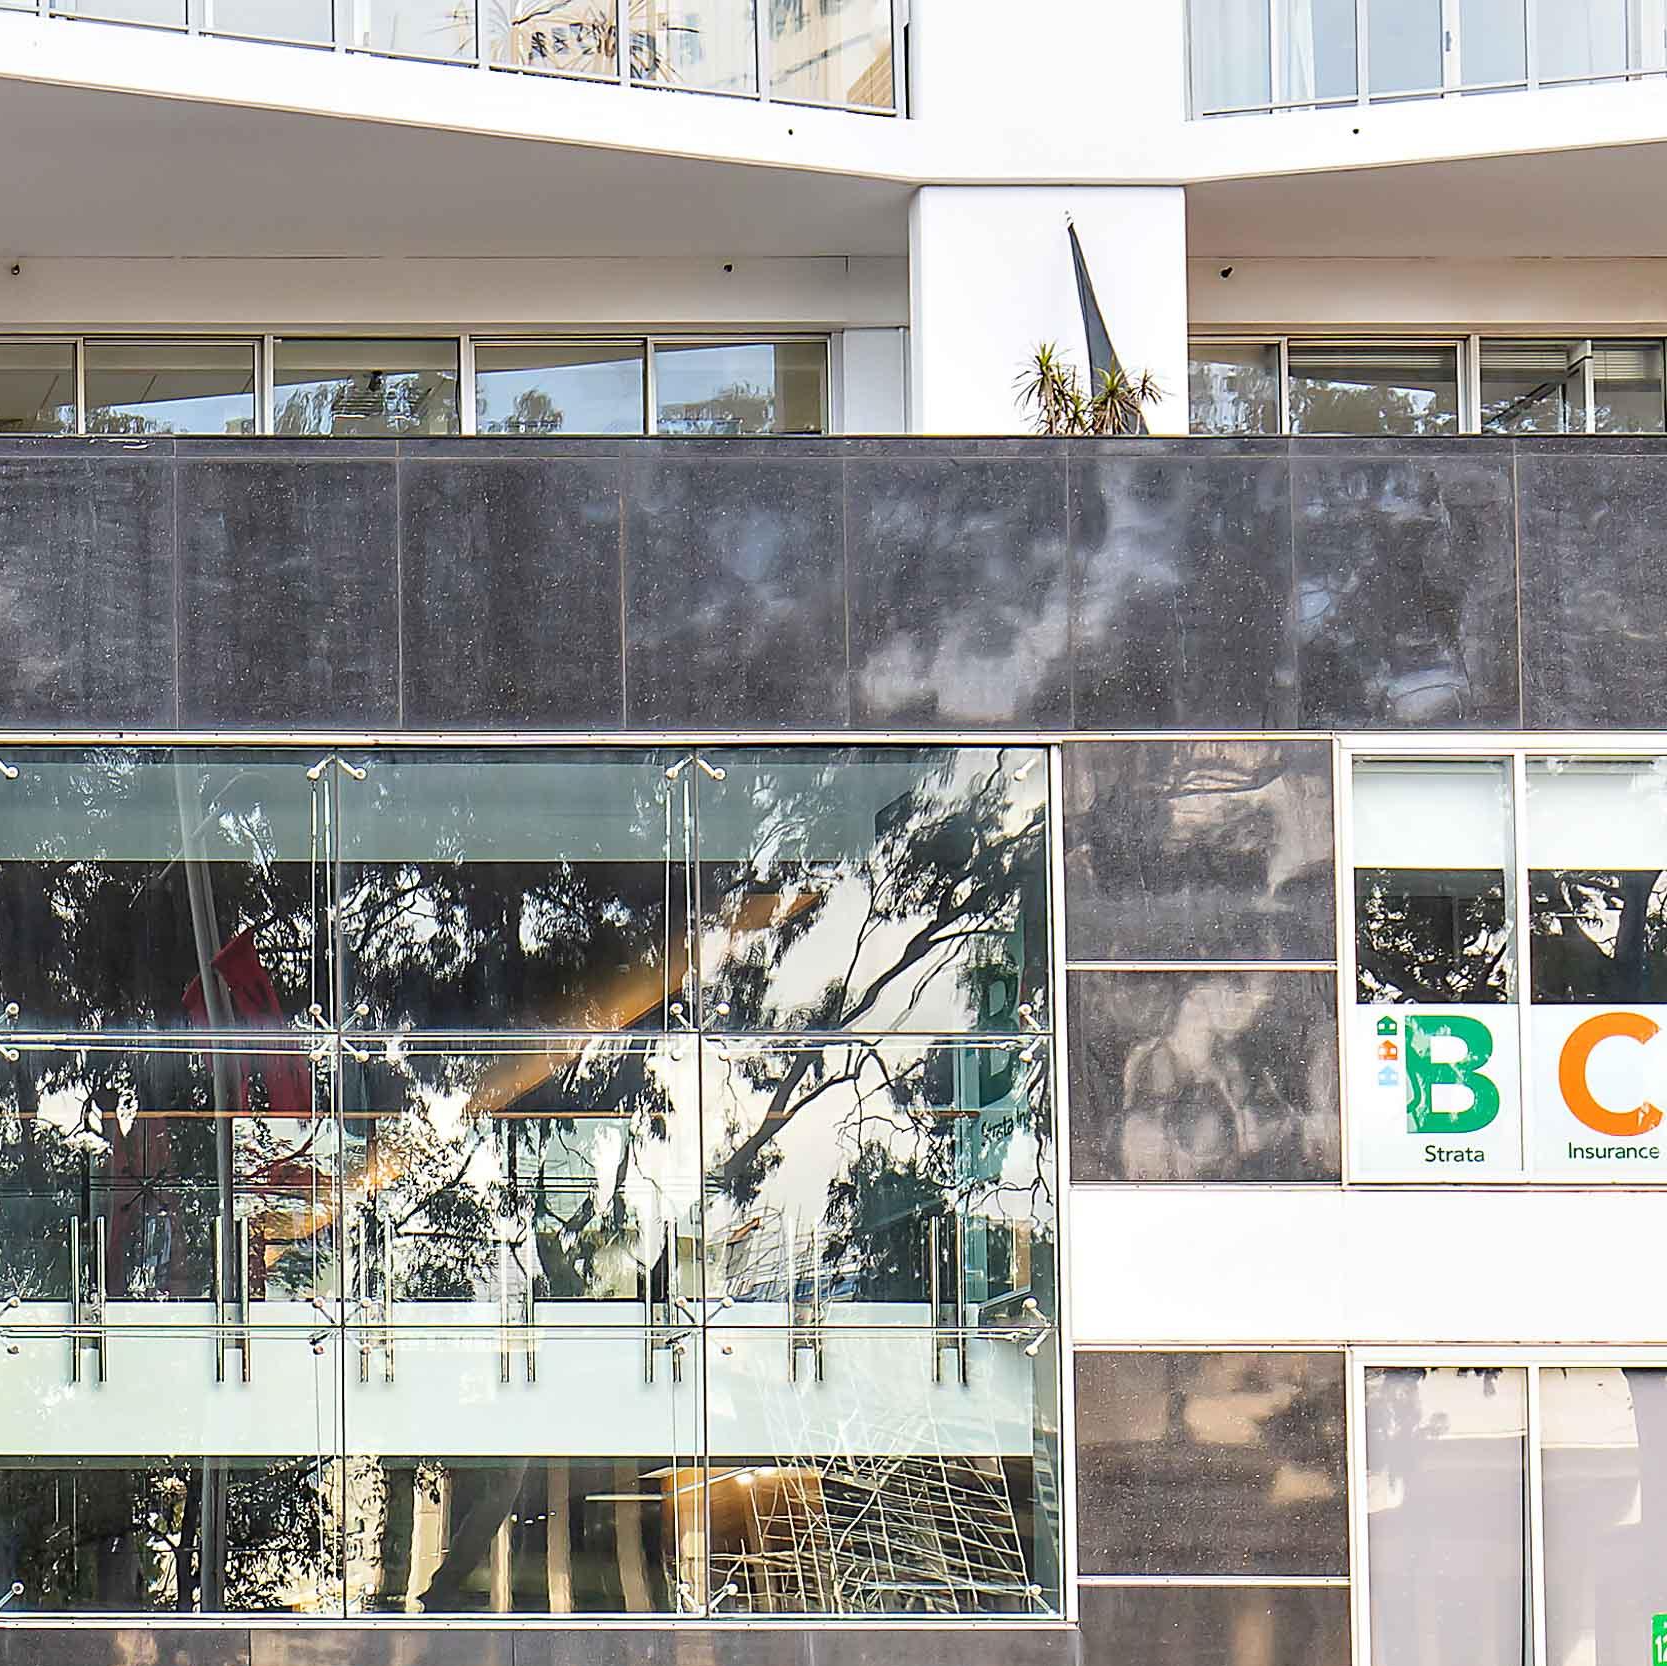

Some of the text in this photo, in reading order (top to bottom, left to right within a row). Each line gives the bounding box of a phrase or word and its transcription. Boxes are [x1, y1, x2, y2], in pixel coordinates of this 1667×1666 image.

[1405, 1015, 1500, 1133] B
[1559, 1012, 1663, 1136] C
[1425, 1144, 1485, 1162] Strata
[1568, 1142, 1660, 1160] Insurance
